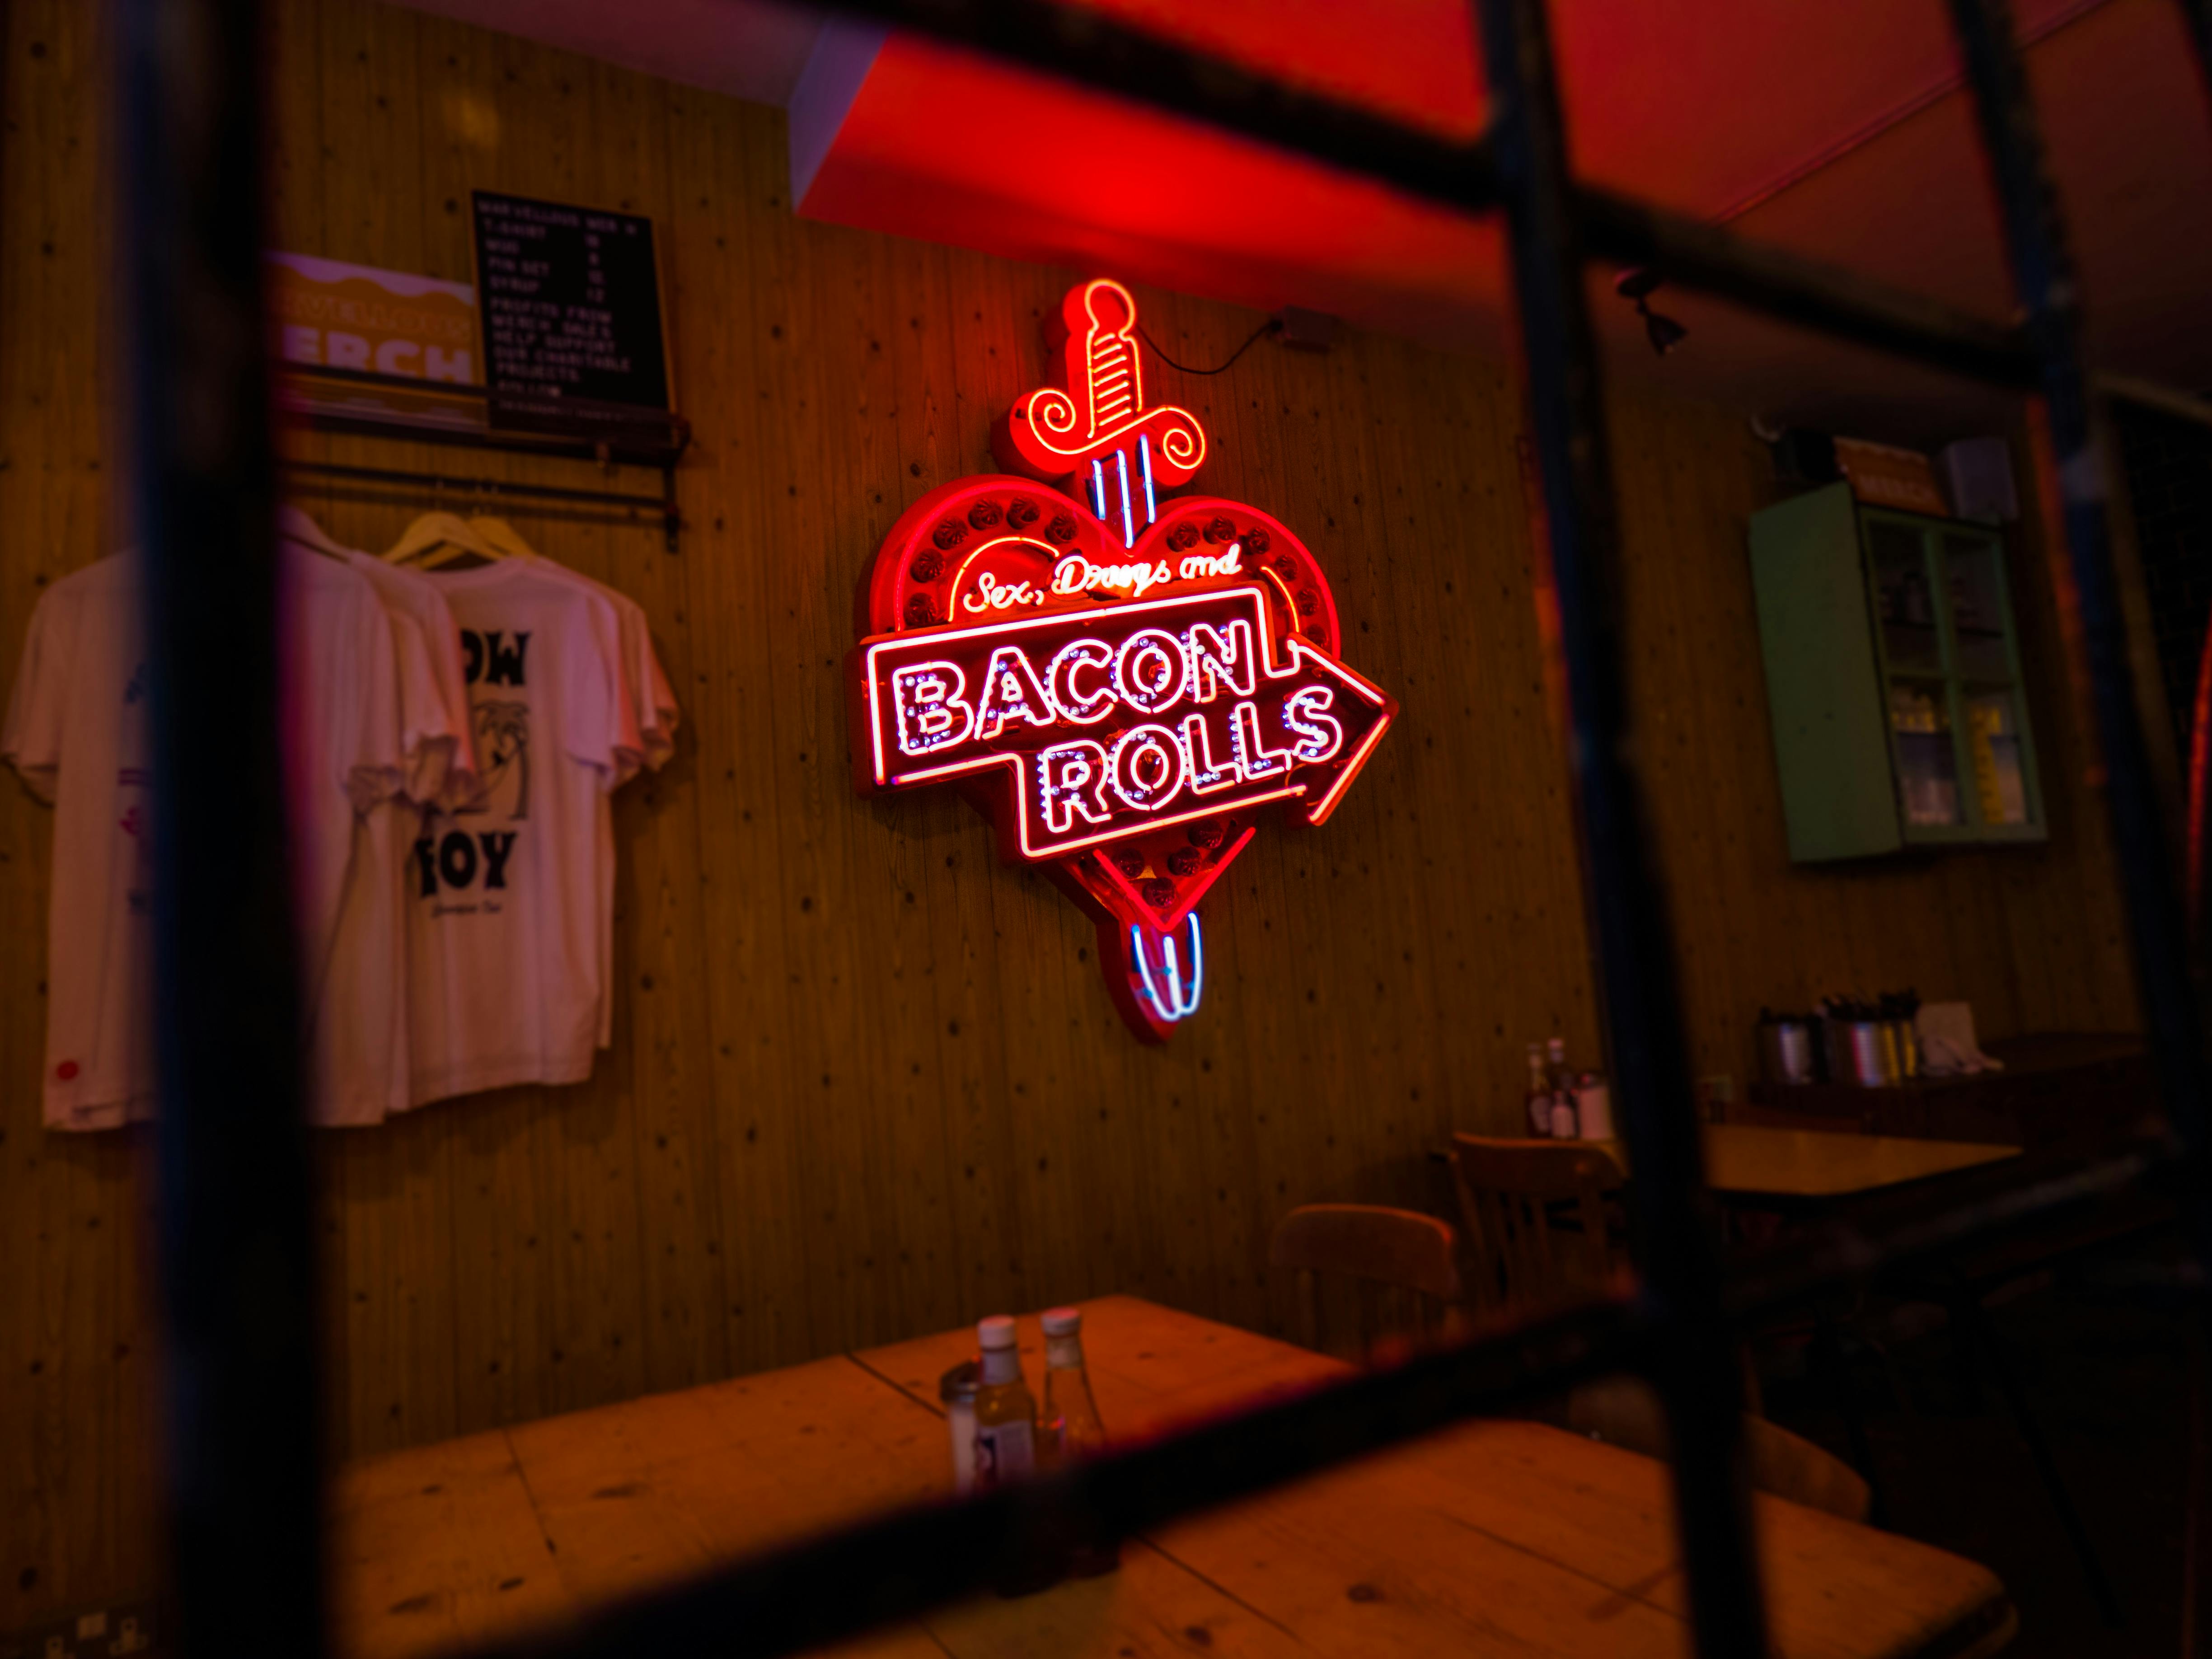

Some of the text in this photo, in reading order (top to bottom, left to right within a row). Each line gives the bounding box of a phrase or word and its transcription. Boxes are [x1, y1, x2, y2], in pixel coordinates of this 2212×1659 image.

[282, 323, 473, 385] ERCH
[964, 543, 1242, 613] Sex, Drugs and
[461, 629, 531, 685] OW
[893, 619, 1256, 756] BACON
[1037, 686, 1343, 833] ROLLS
